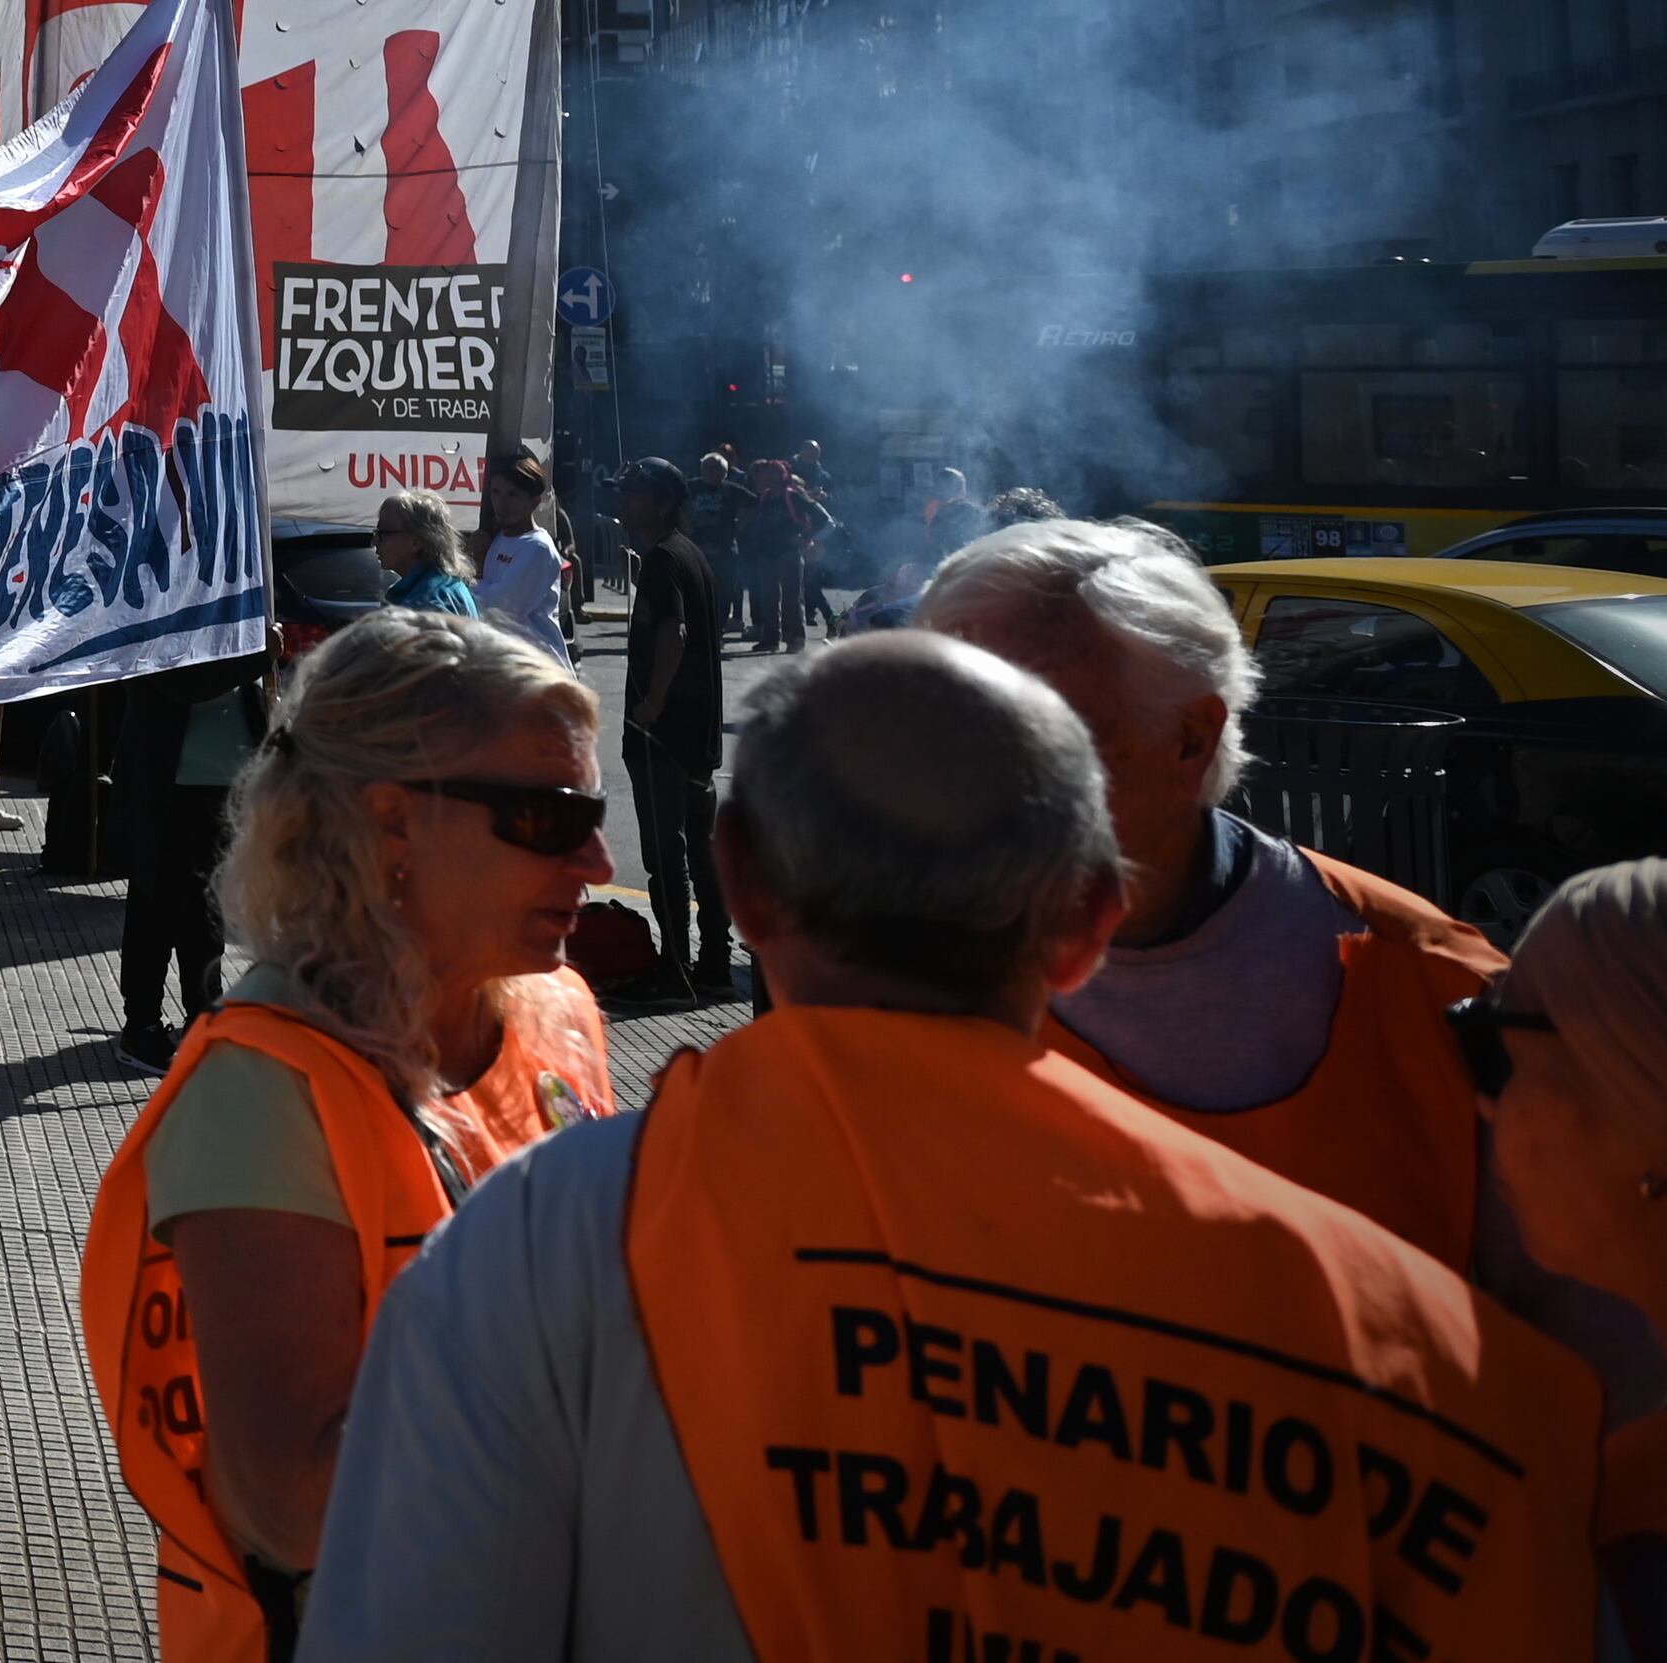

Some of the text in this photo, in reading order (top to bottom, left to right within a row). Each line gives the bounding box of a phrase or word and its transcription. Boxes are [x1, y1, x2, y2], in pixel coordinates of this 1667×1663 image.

[280, 274, 485, 333] FRENTE
[278, 335, 496, 398] IZQUIER
[371, 398, 386, 417] Y
[393, 398, 422, 419] DE
[1315, 529, 1341, 548] 98
[830, 1305, 1490, 1596] PENARIO DE
[765, 1444, 1432, 1663] TRABAJADO
